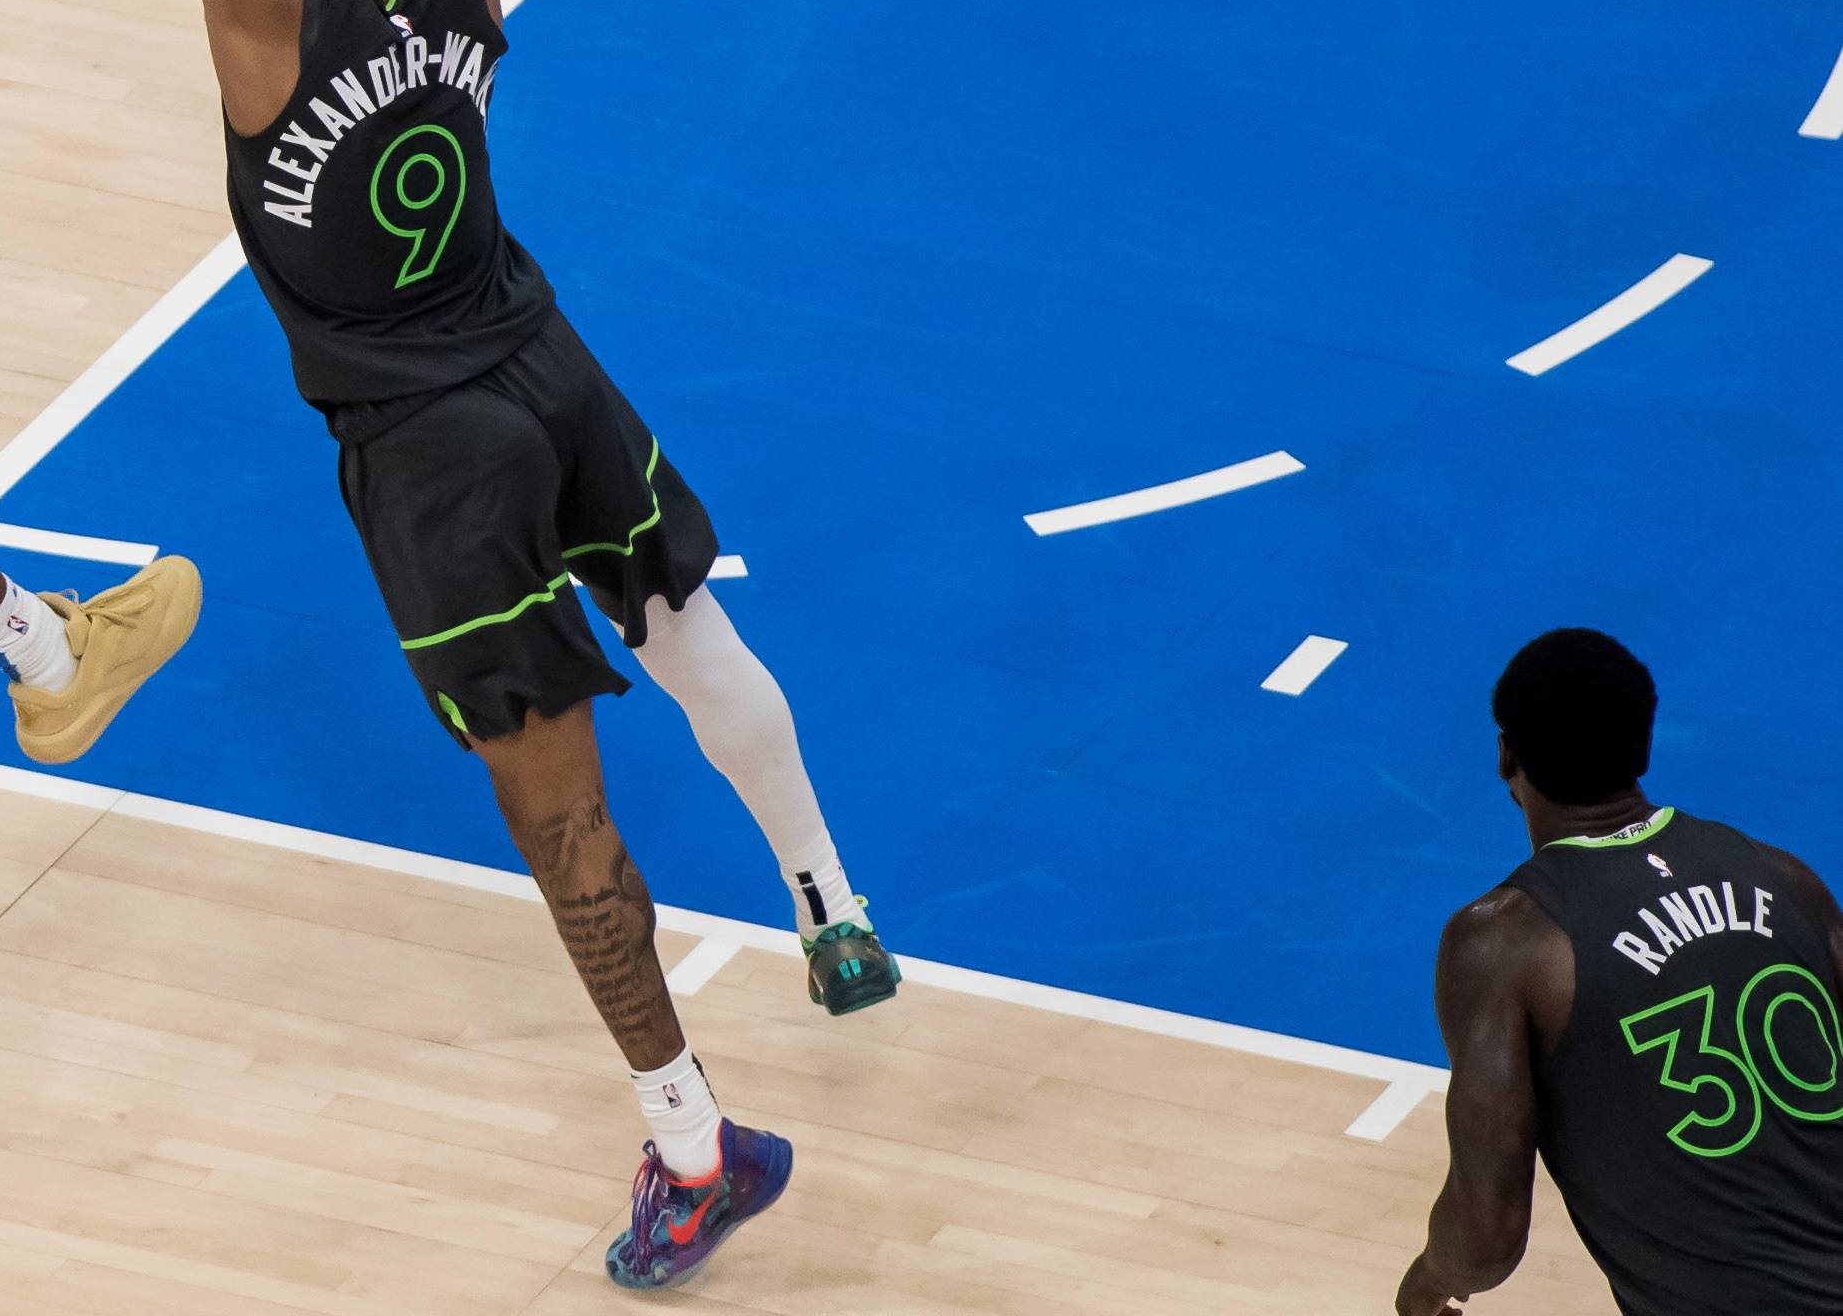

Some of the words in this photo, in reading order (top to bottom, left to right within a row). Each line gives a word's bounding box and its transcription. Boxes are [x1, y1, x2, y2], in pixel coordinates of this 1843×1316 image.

[370, 124, 466, 289] 9
[1612, 881, 1774, 976] RANDLE
[1619, 963, 1843, 1158] 30
